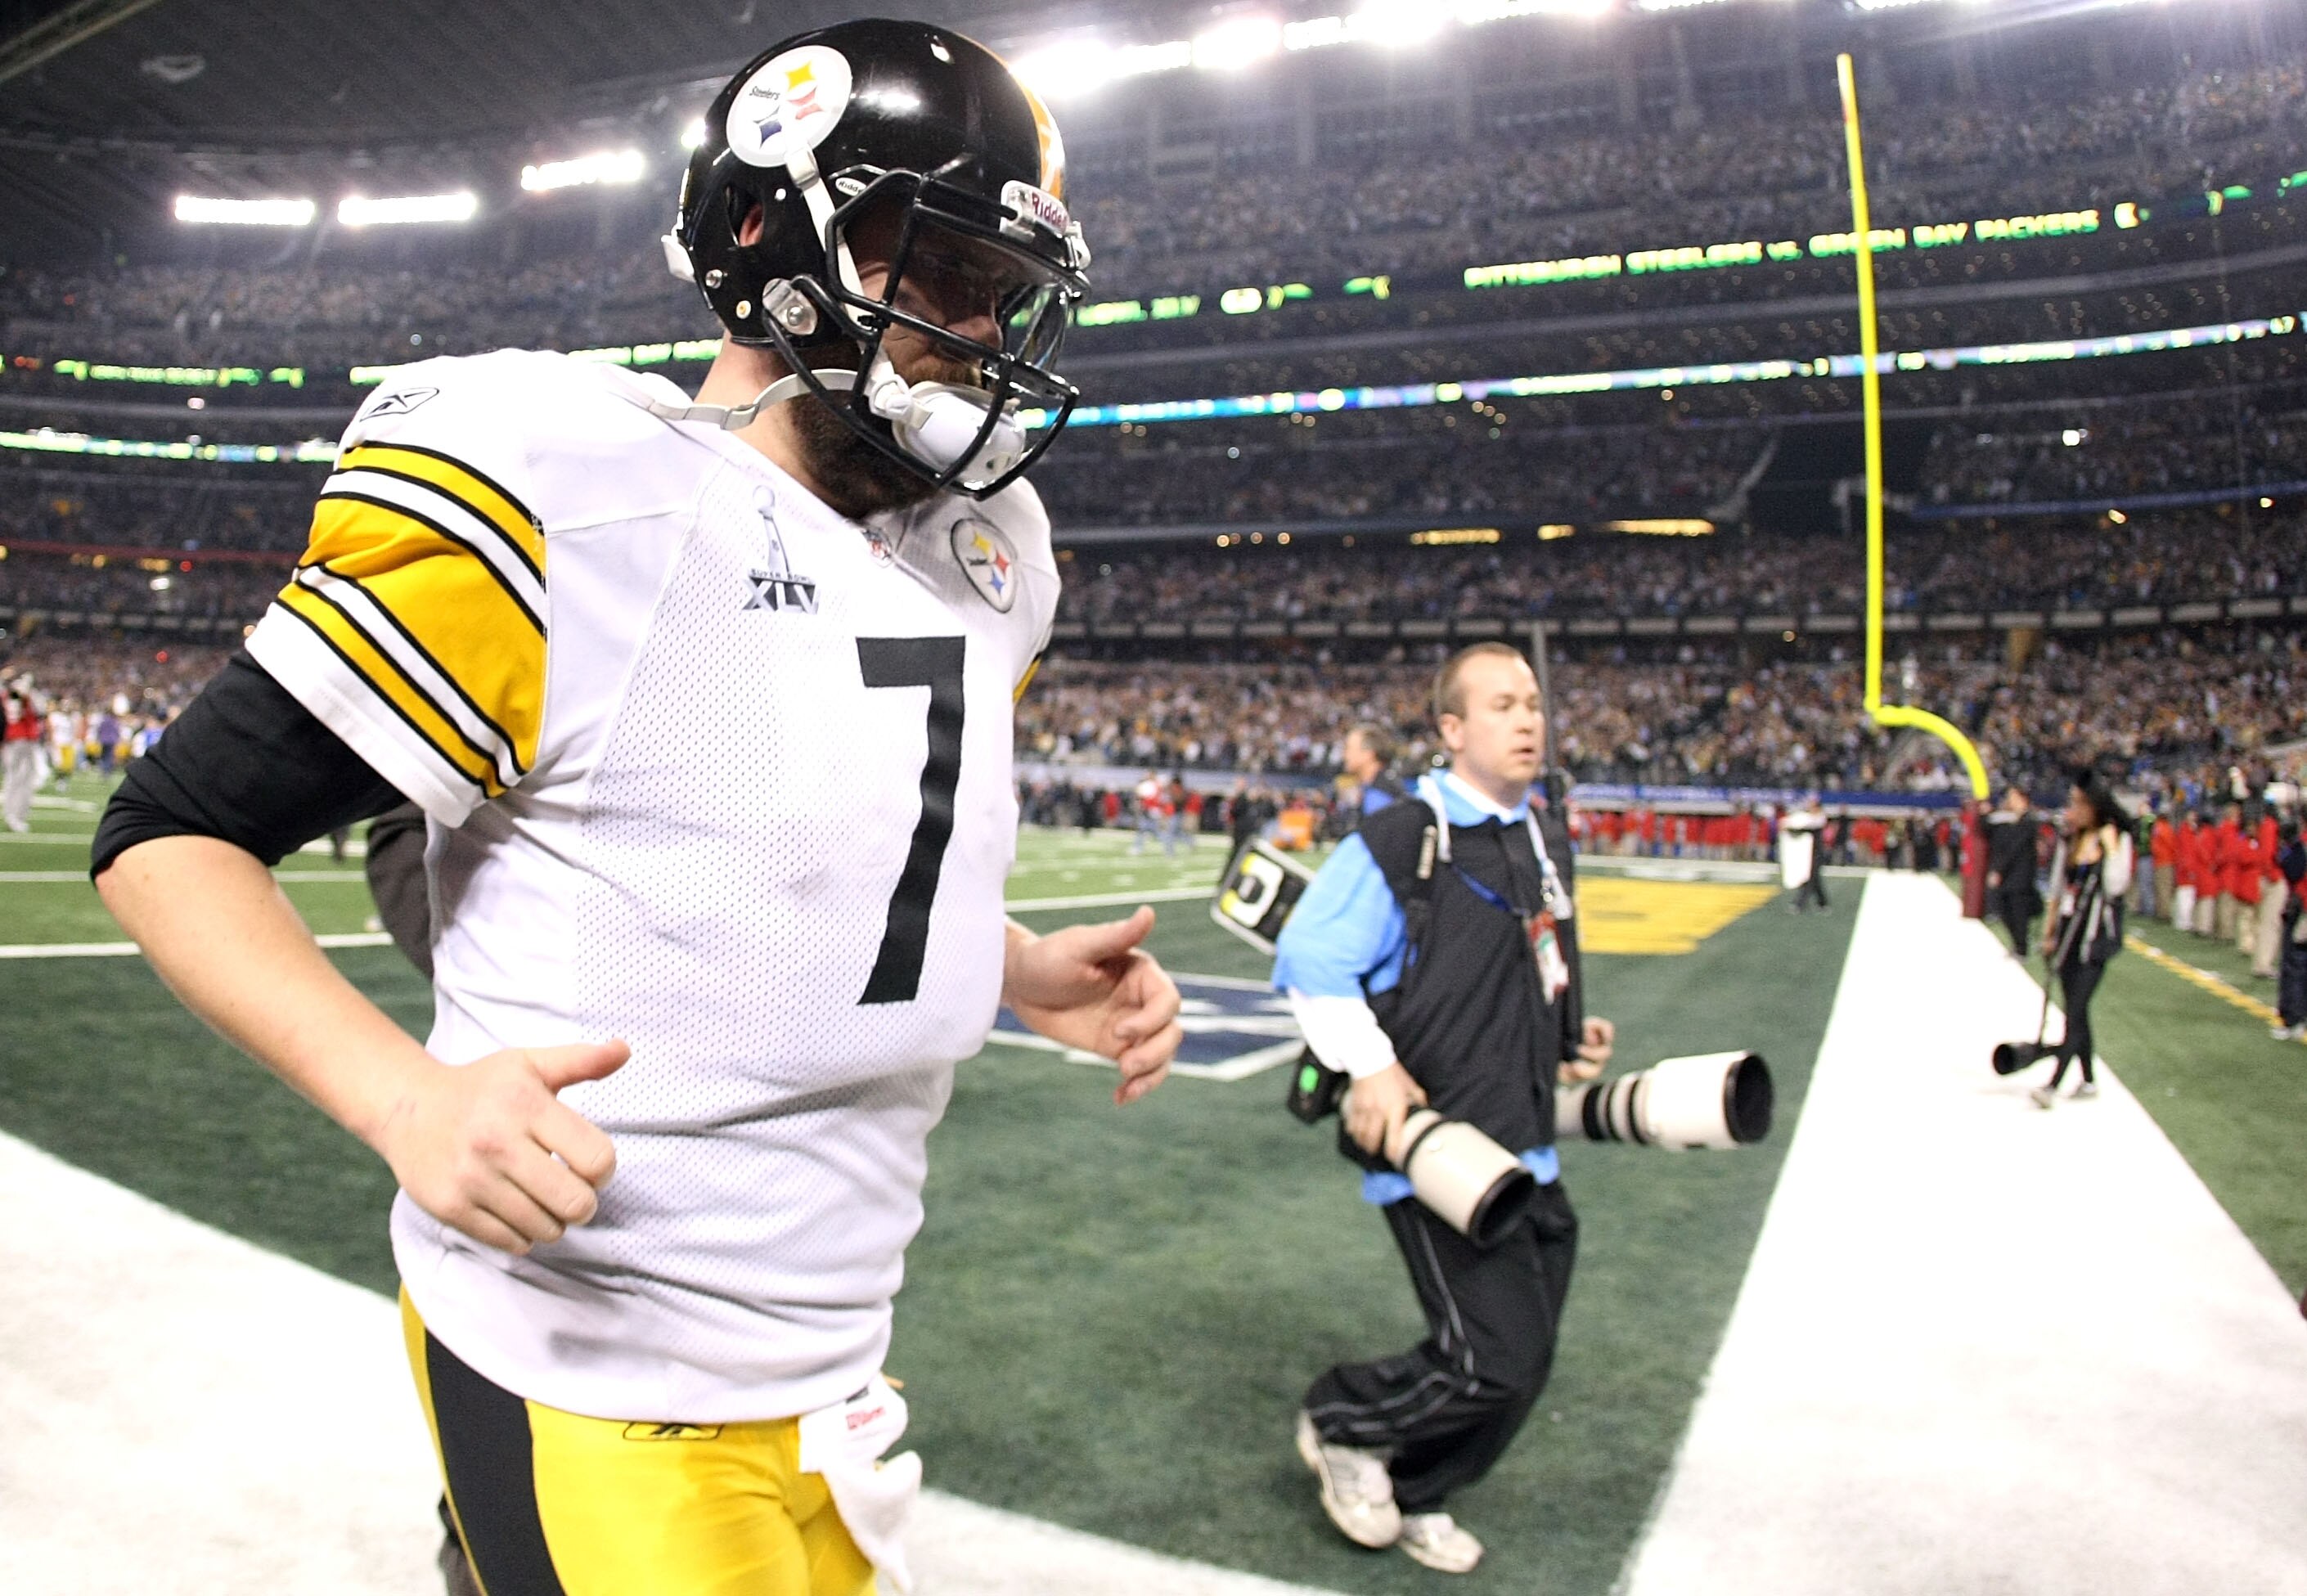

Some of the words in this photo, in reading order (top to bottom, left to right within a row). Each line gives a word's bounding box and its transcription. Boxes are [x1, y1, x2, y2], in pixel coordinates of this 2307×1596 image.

[1626, 241, 1762, 275] STEELERS
[1913, 222, 1968, 249] BAY
[1975, 209, 2100, 243] PACKERS
[741, 578, 821, 616] XLV
[856, 636, 966, 1005] 7
